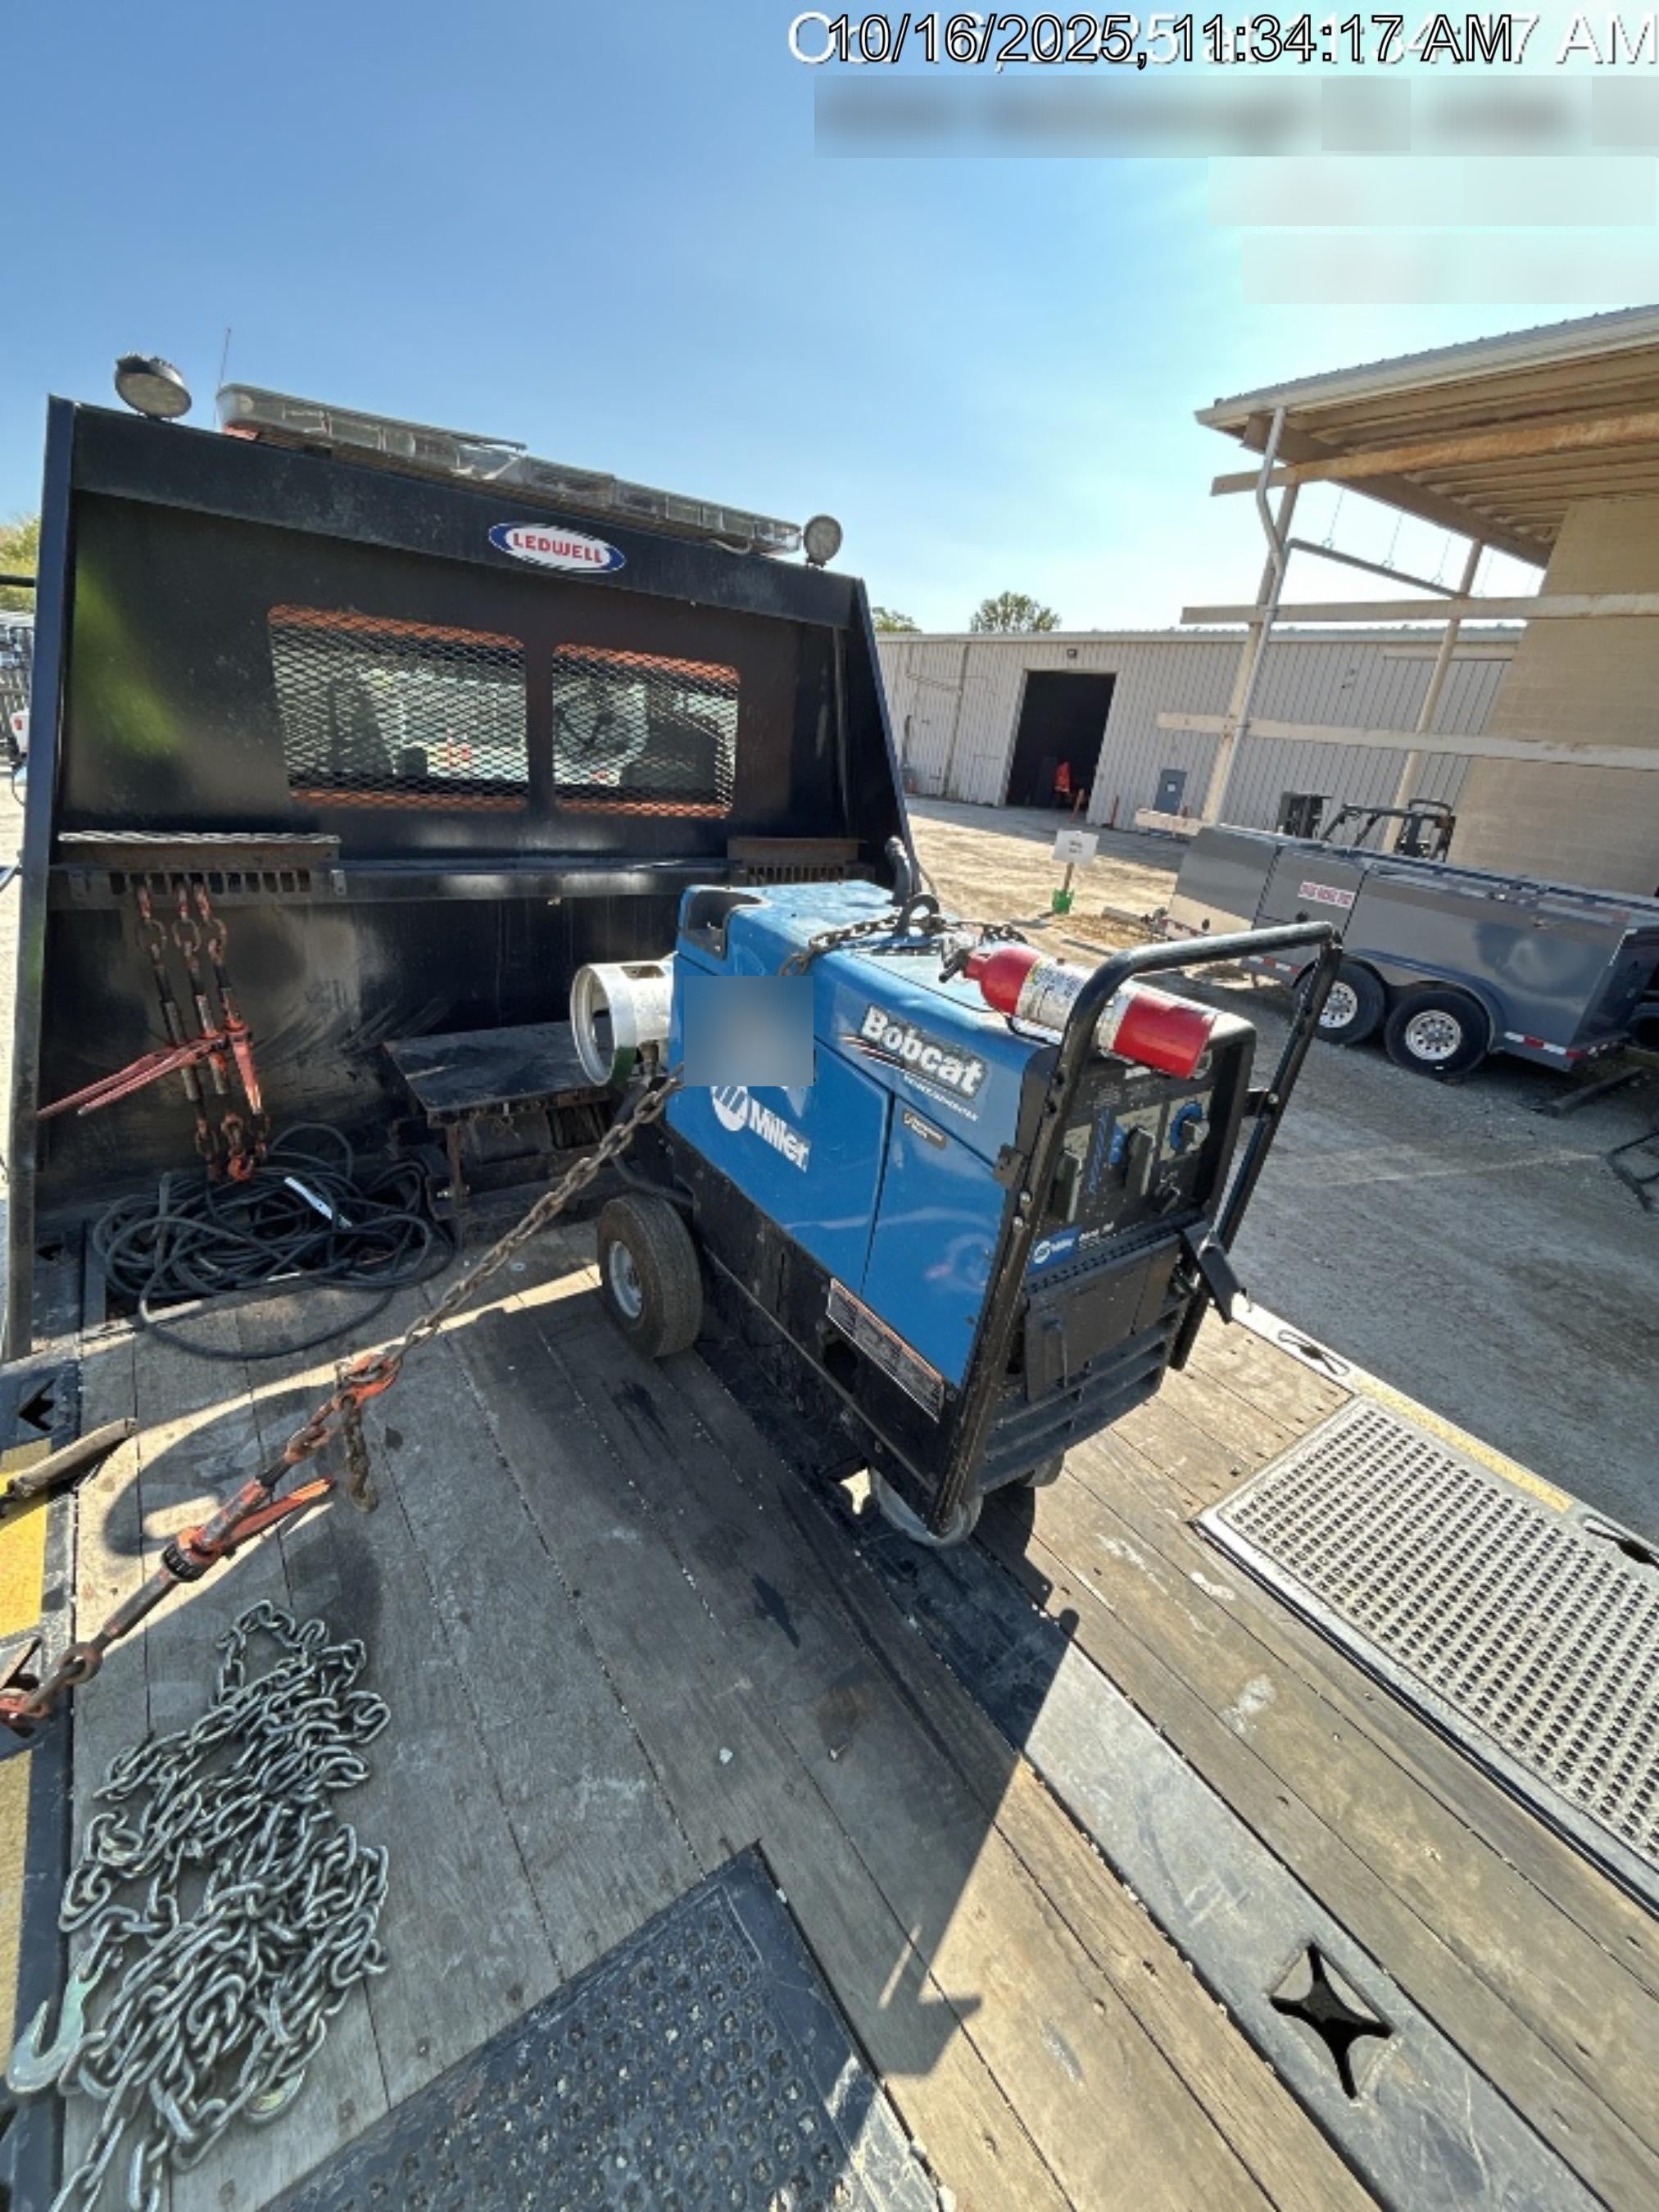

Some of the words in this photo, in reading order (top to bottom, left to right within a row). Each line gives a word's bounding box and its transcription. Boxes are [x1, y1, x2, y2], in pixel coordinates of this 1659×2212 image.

[513, 533, 603, 564] LEDWELL
[861, 1005, 984, 1096] Bobcat
[749, 1096, 809, 1170] Miller
